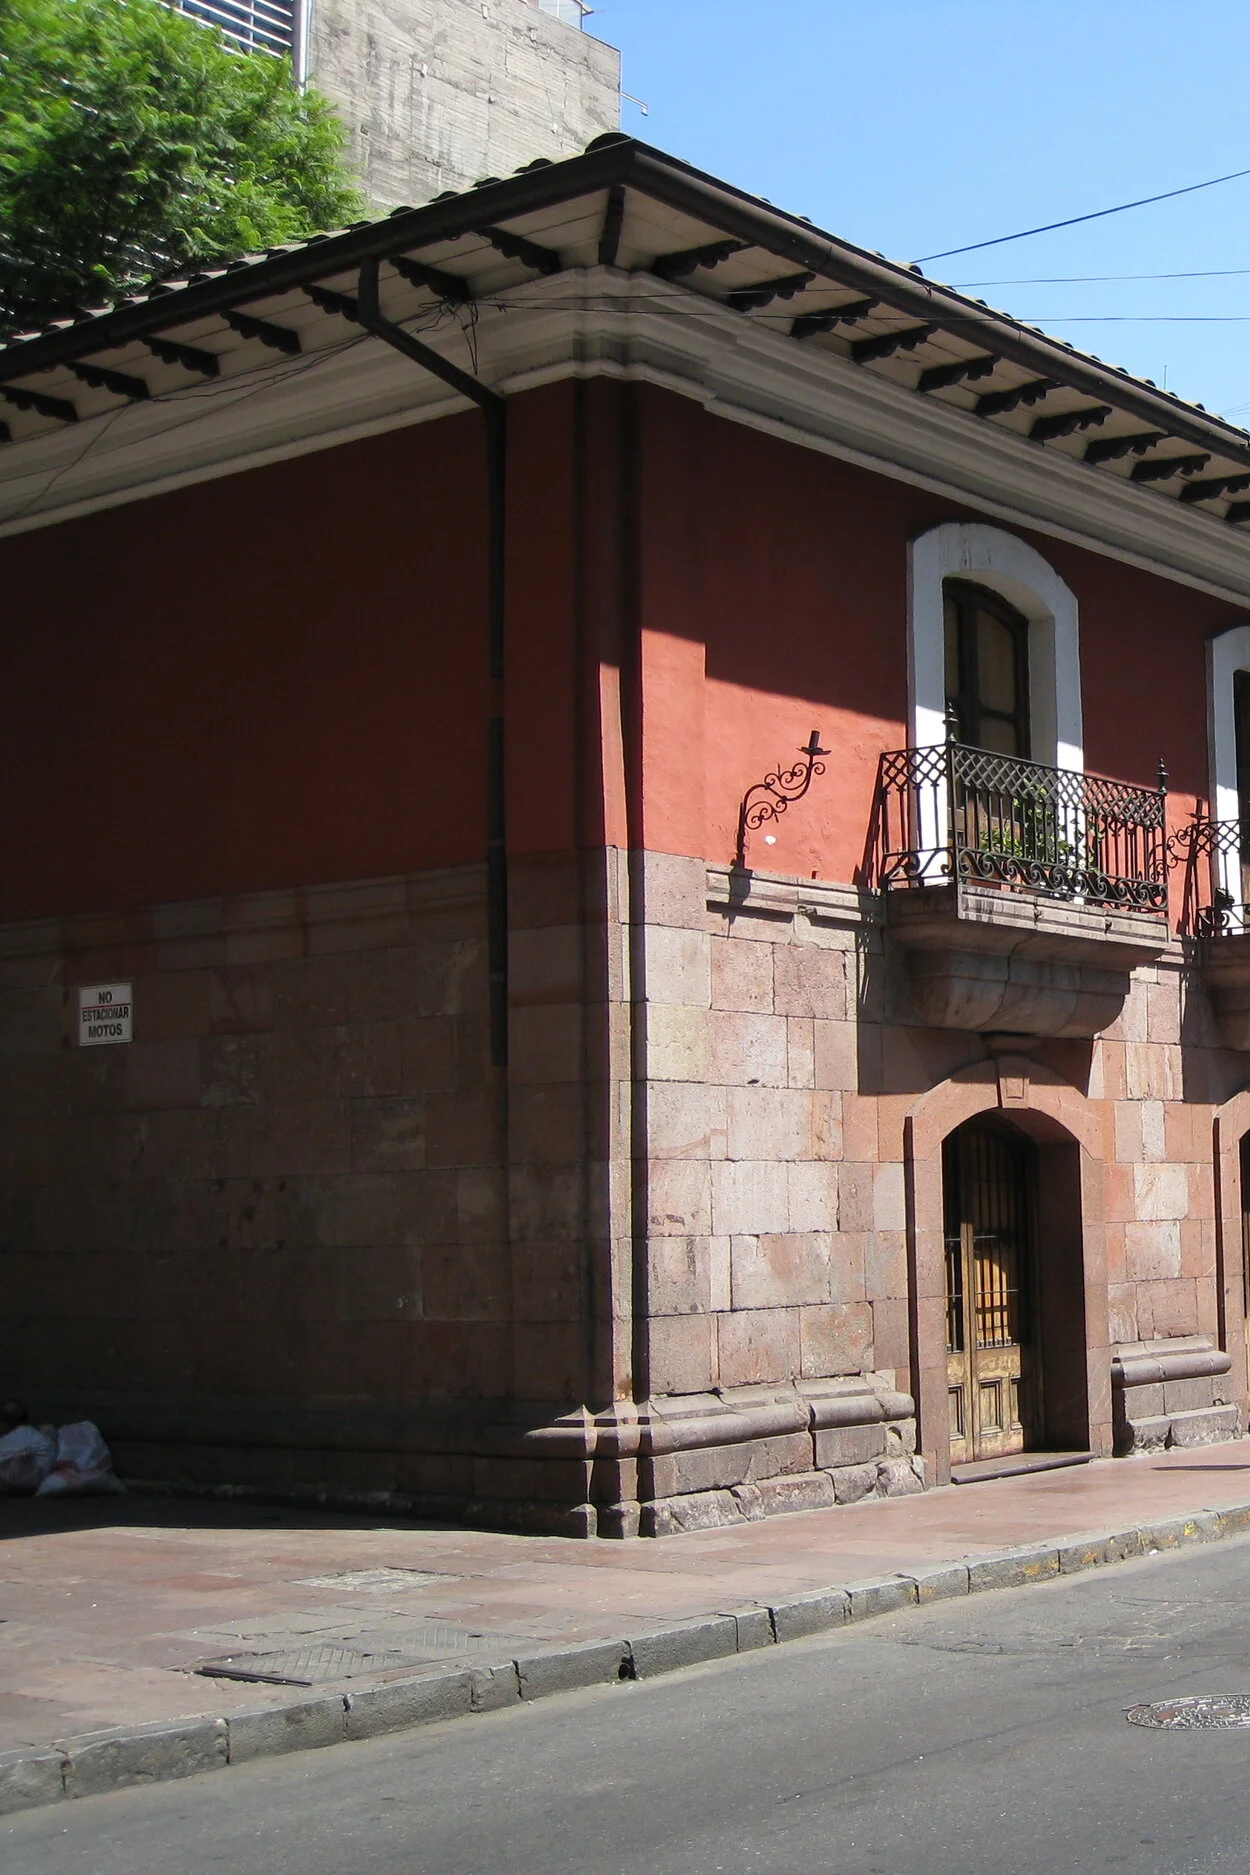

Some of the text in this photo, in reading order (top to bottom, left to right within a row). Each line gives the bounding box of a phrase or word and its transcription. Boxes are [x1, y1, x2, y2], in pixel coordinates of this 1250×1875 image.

[98, 991, 112, 1004] NO
[82, 1006, 129, 1022] ESTACIONAR
[88, 1023, 123, 1038] MOTOS
